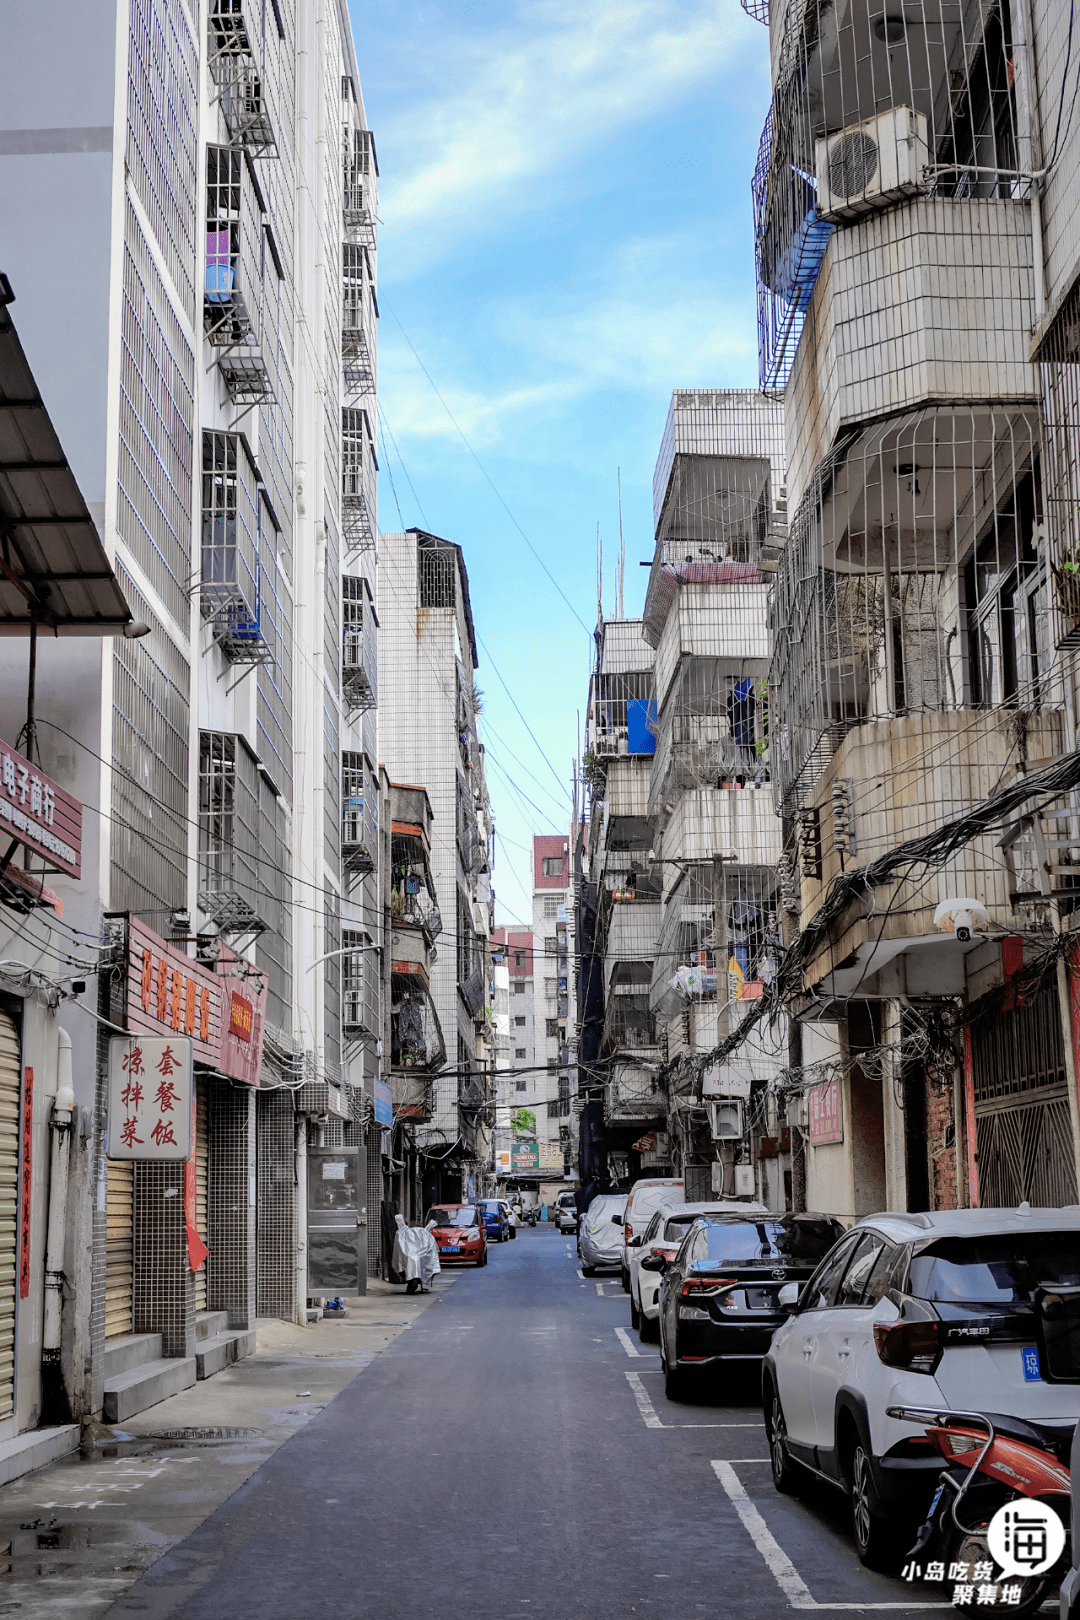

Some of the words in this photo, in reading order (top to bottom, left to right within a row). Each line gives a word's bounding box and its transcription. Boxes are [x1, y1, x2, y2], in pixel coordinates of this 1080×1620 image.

[0, 753, 55, 826] 电子商行
[120, 1046, 145, 1149] 凉拌菜
[150, 1045, 183, 1147] 套餐饭
